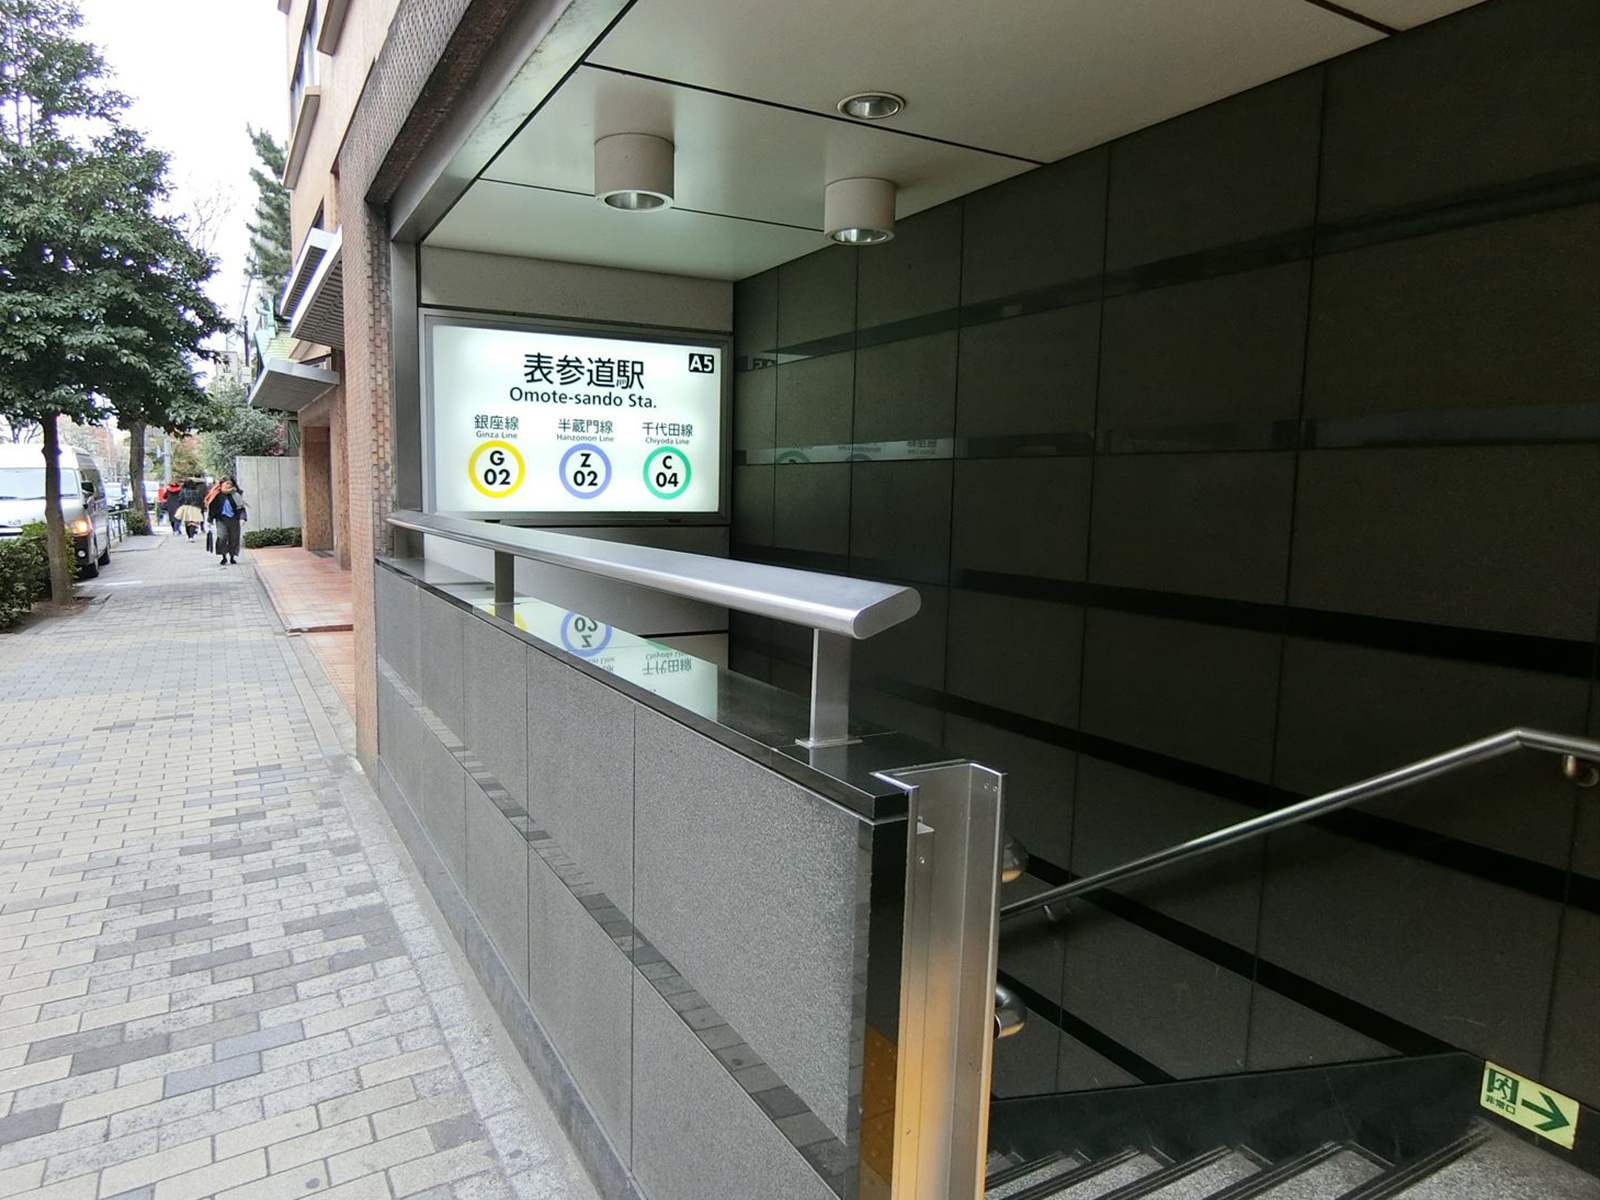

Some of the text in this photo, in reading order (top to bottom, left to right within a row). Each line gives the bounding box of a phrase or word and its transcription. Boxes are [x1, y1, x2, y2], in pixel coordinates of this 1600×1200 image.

[523, 352, 645, 390] 表参道駅
[689, 354, 714, 373] A5
[509, 386, 658, 409] Omote-sando Sta.
[474, 414, 520, 431] 銀座線
[558, 418, 614, 434] 半蔵門線
[642, 421, 694, 438] 千代田線
[475, 430, 518, 440] Ginza Line
[556, 433, 615, 443] Hanzomon Line
[645, 436, 674, 446] Chiyoda
[489, 450, 506, 466] G
[579, 453, 592, 468] Z
[661, 455, 673, 470] C
[483, 468, 511, 486] 02
[572, 470, 598, 487] 02
[655, 471, 679, 488] 04
[1485, 1094, 1516, 1115] 非常口
